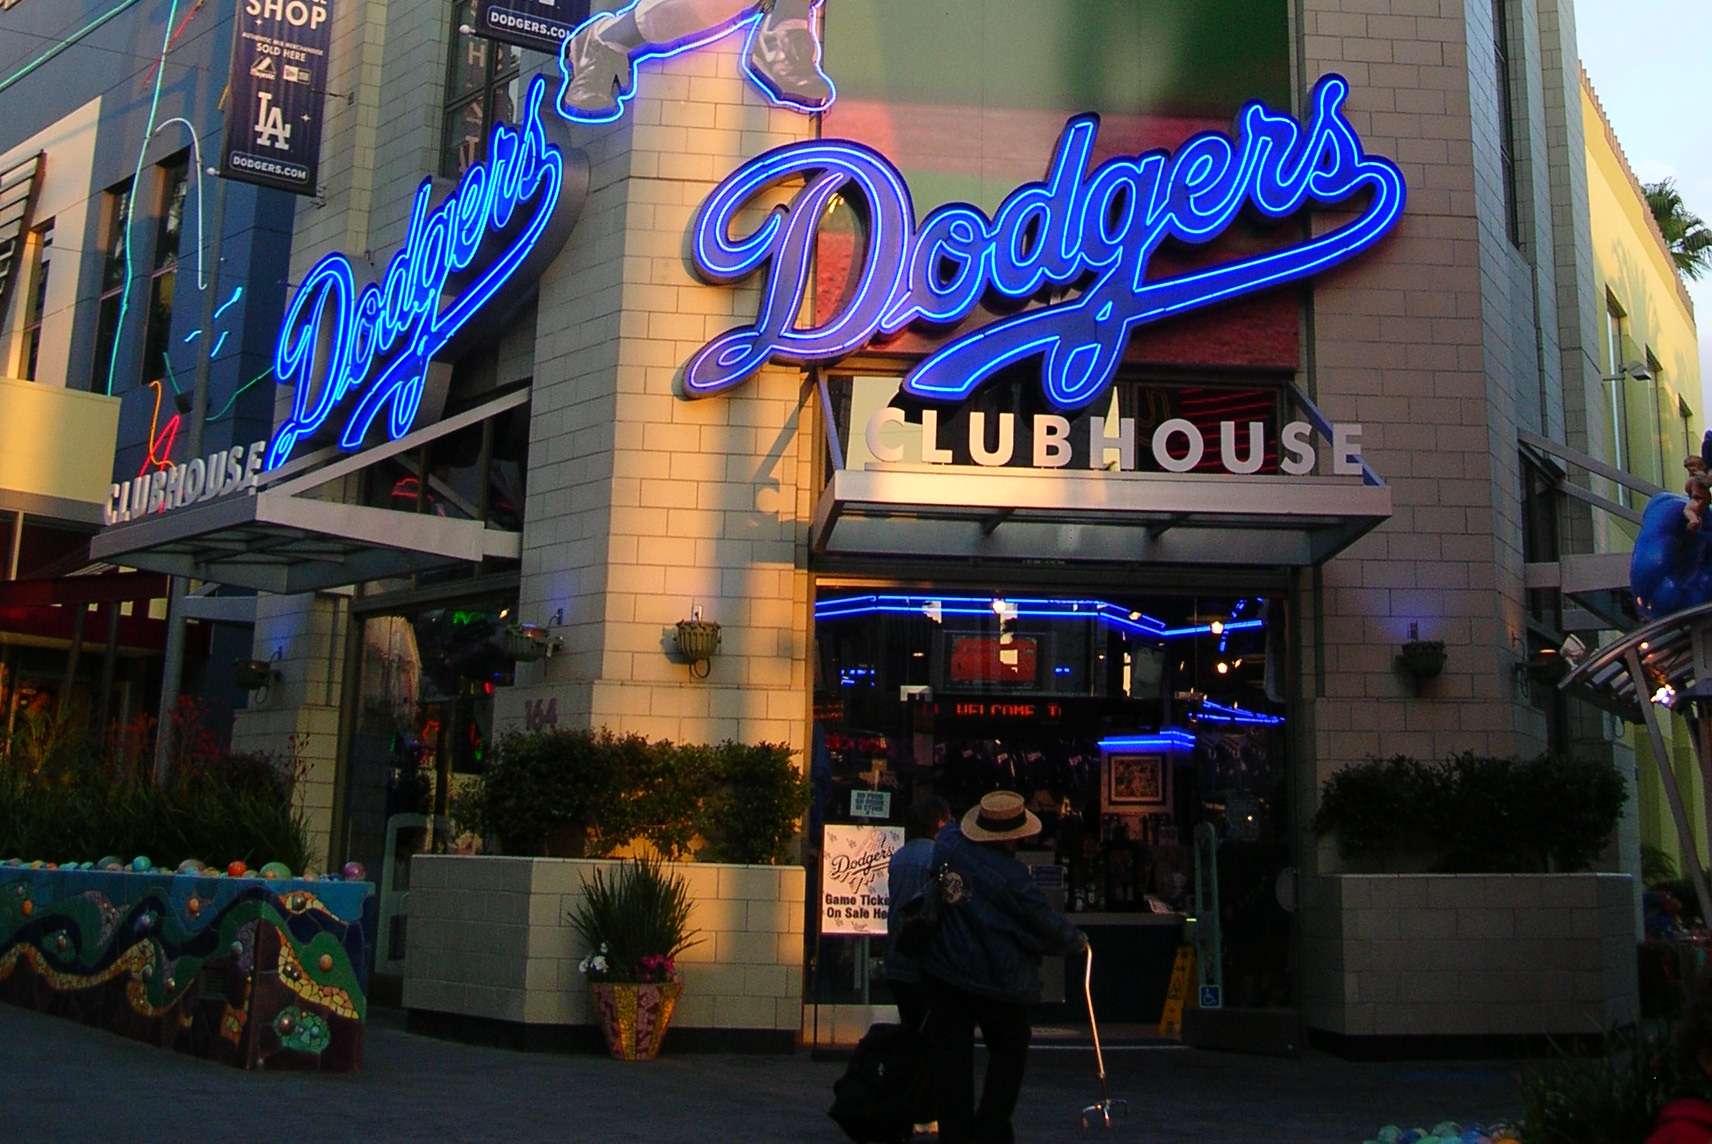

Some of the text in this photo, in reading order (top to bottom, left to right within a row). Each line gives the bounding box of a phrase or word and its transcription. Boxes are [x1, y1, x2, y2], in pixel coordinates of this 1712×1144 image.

[256, 42, 306, 62] SOLD HERE
[254, 91, 291, 150] LA
[233, 156, 306, 179] DODGERS.COM
[682, 73, 1407, 412] Dodgers
[268, 74, 564, 472] Dodgers
[864, 408, 1367, 476] CLUBHOUSE
[104, 440, 266, 525] CLUBHOUSE
[825, 894, 889, 906] Game Ticke
[826, 907, 888, 920] On Sale He
